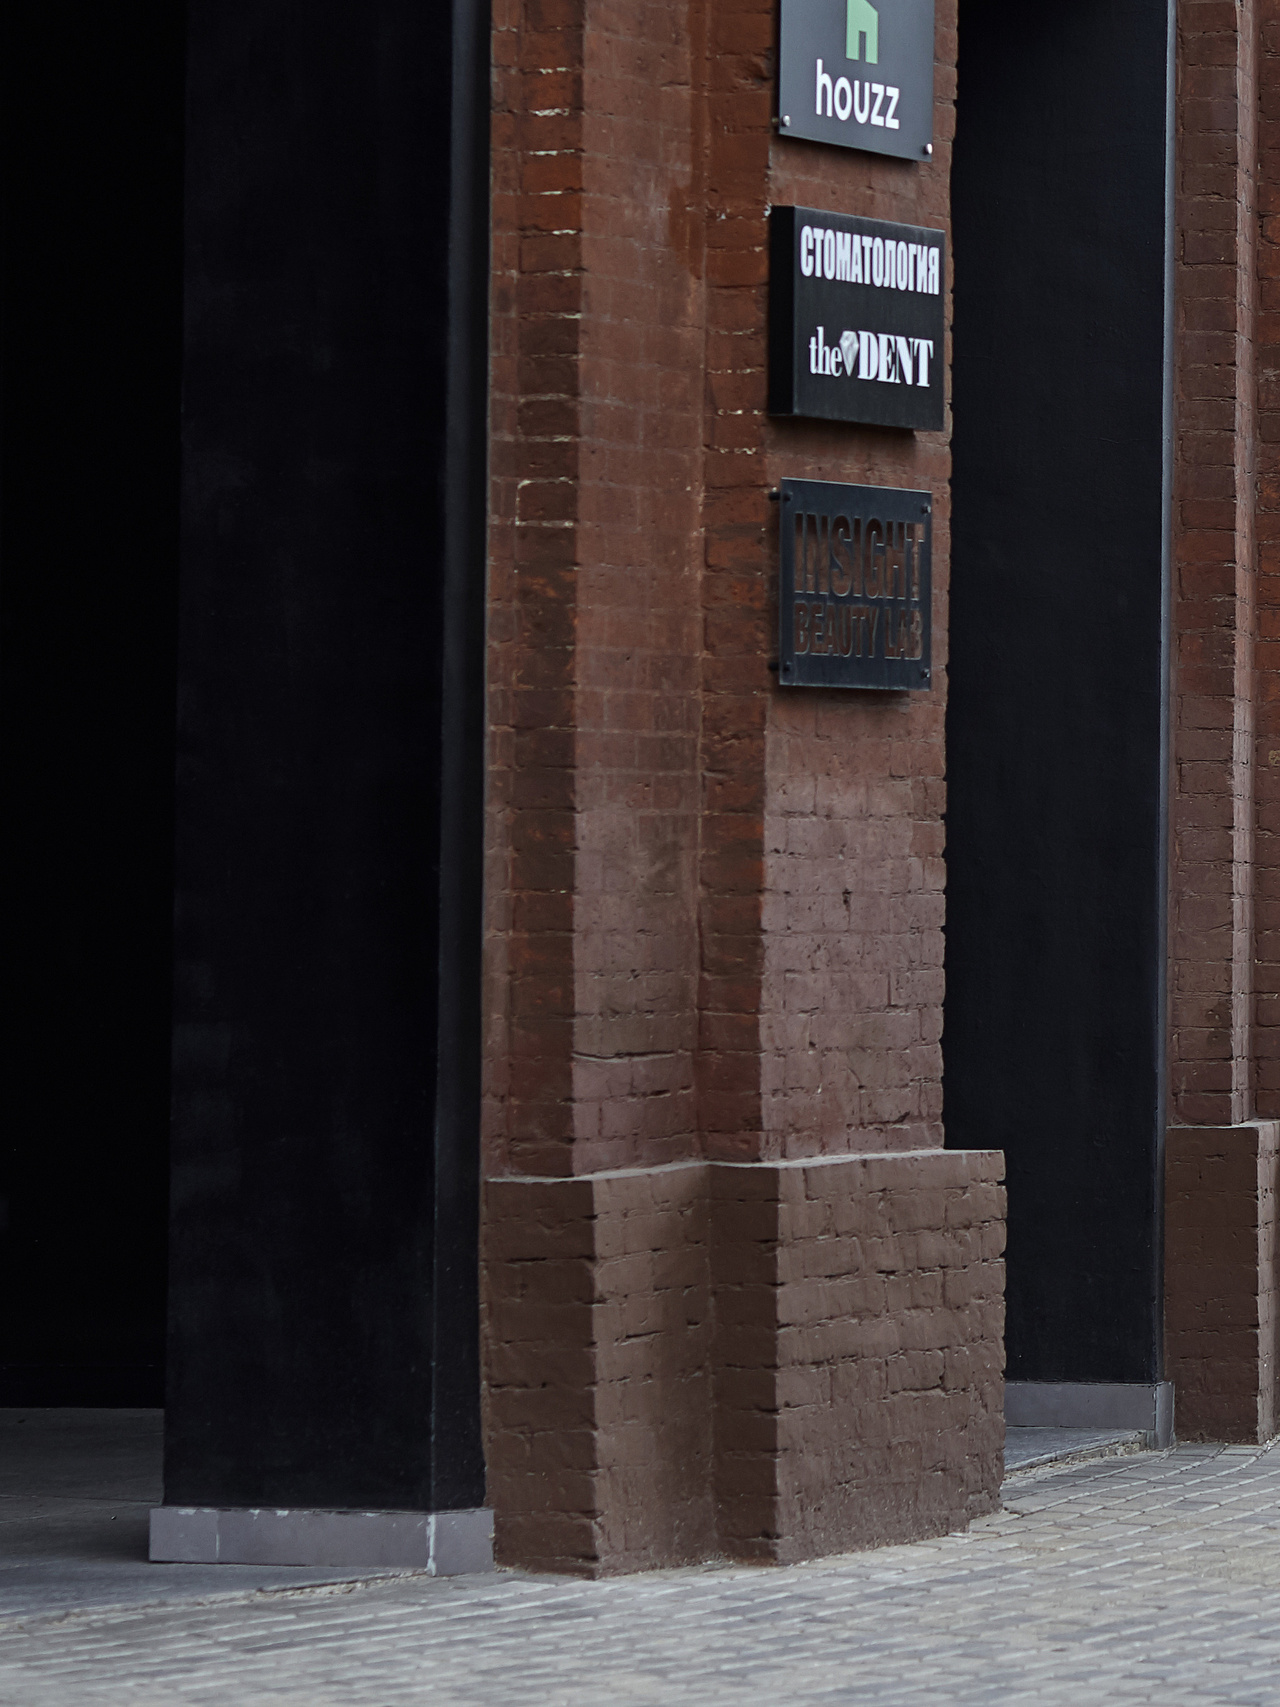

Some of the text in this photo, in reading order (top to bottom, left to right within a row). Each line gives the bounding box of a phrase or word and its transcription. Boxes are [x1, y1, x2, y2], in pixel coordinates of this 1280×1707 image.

[815, 58, 900, 130] houzz
[800, 225, 940, 296] СТОМАТОЛОГИЯ
[857, 330, 934, 388] DENT
[793, 511, 925, 601] INSIGHT
[793, 601, 924, 661] BEAUTY LAB
